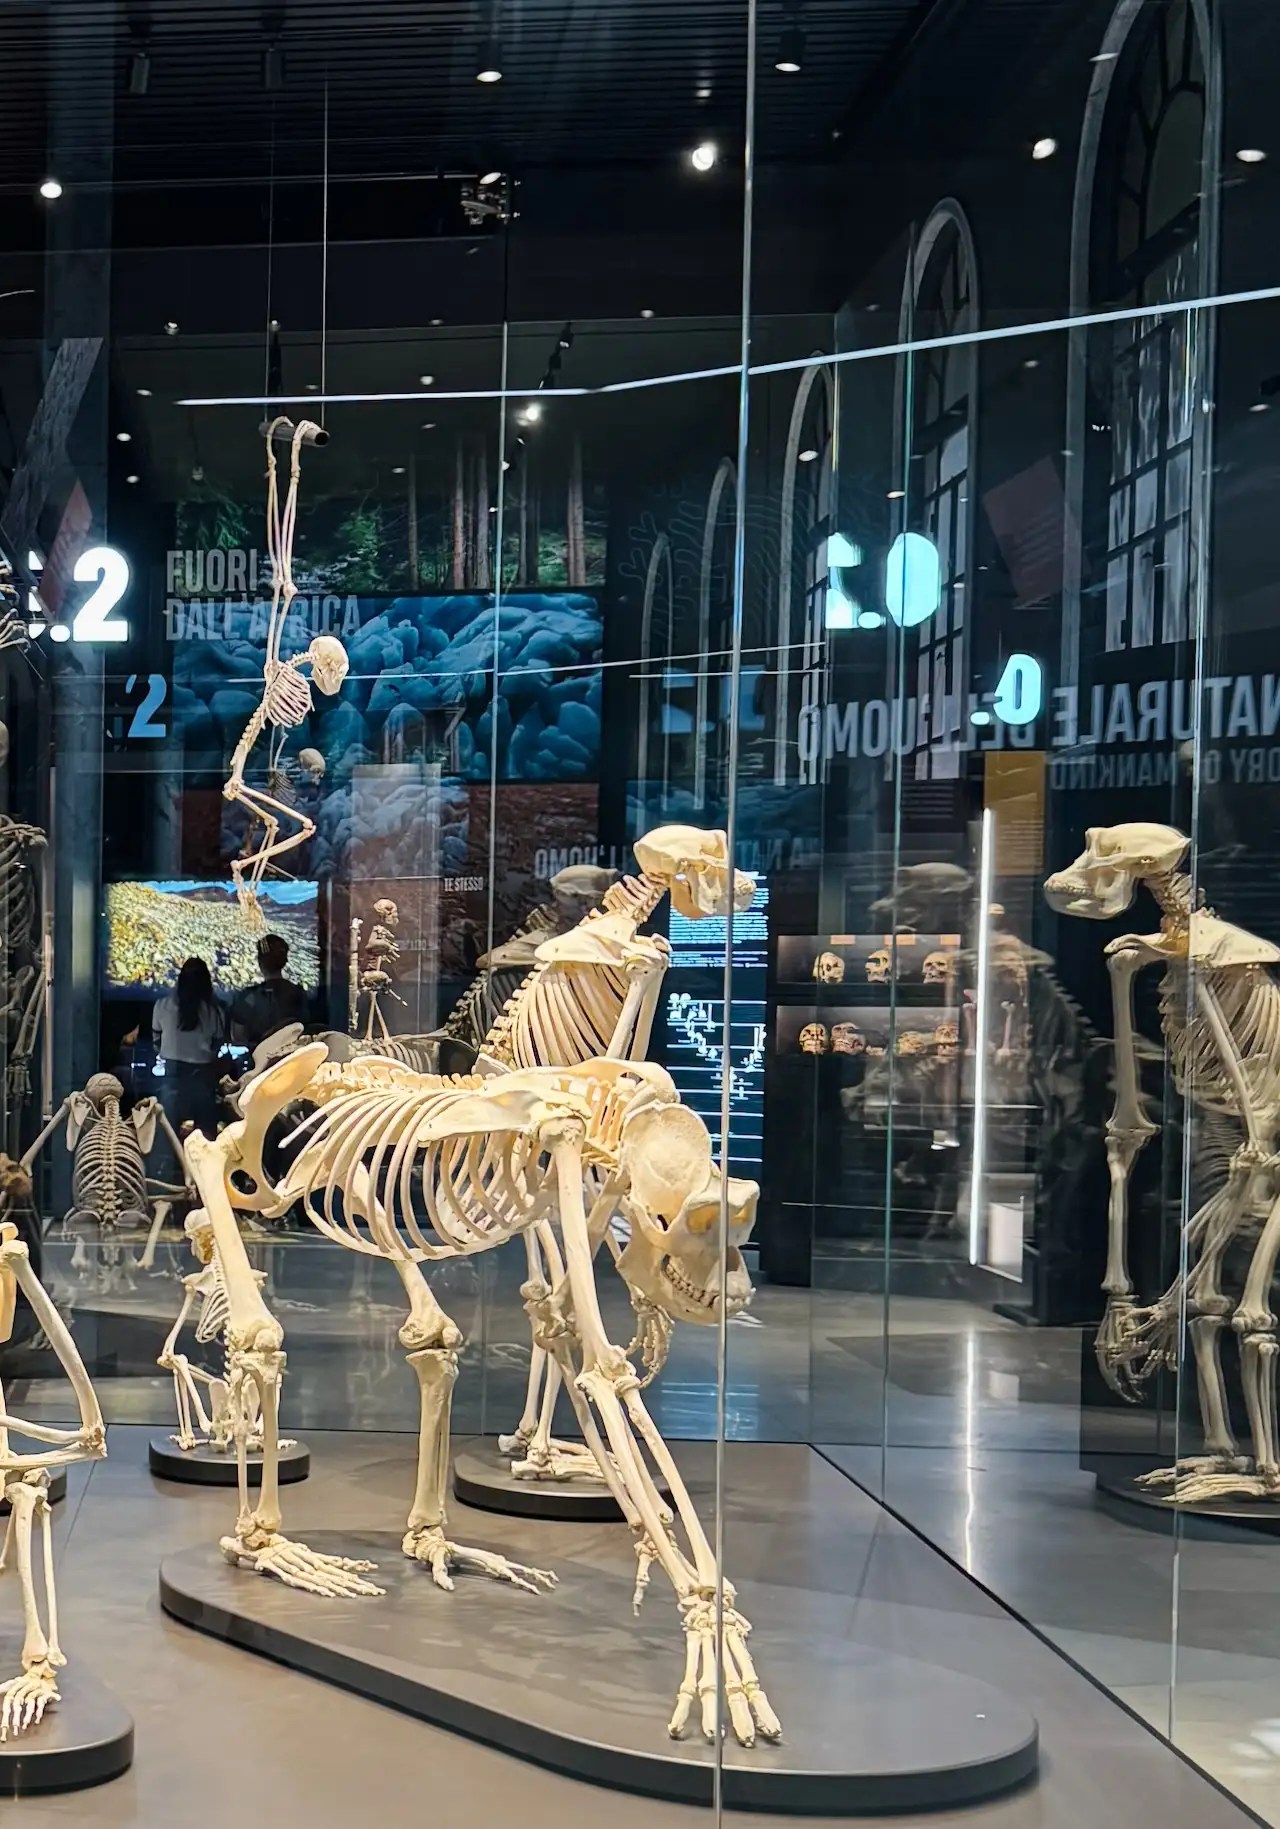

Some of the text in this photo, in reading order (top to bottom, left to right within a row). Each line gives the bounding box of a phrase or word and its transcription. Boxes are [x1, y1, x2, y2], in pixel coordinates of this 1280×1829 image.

[28, 547, 131, 642] .2
[166, 549, 258, 593] FUORI
[165, 594, 361, 641] DALL'ARICA
